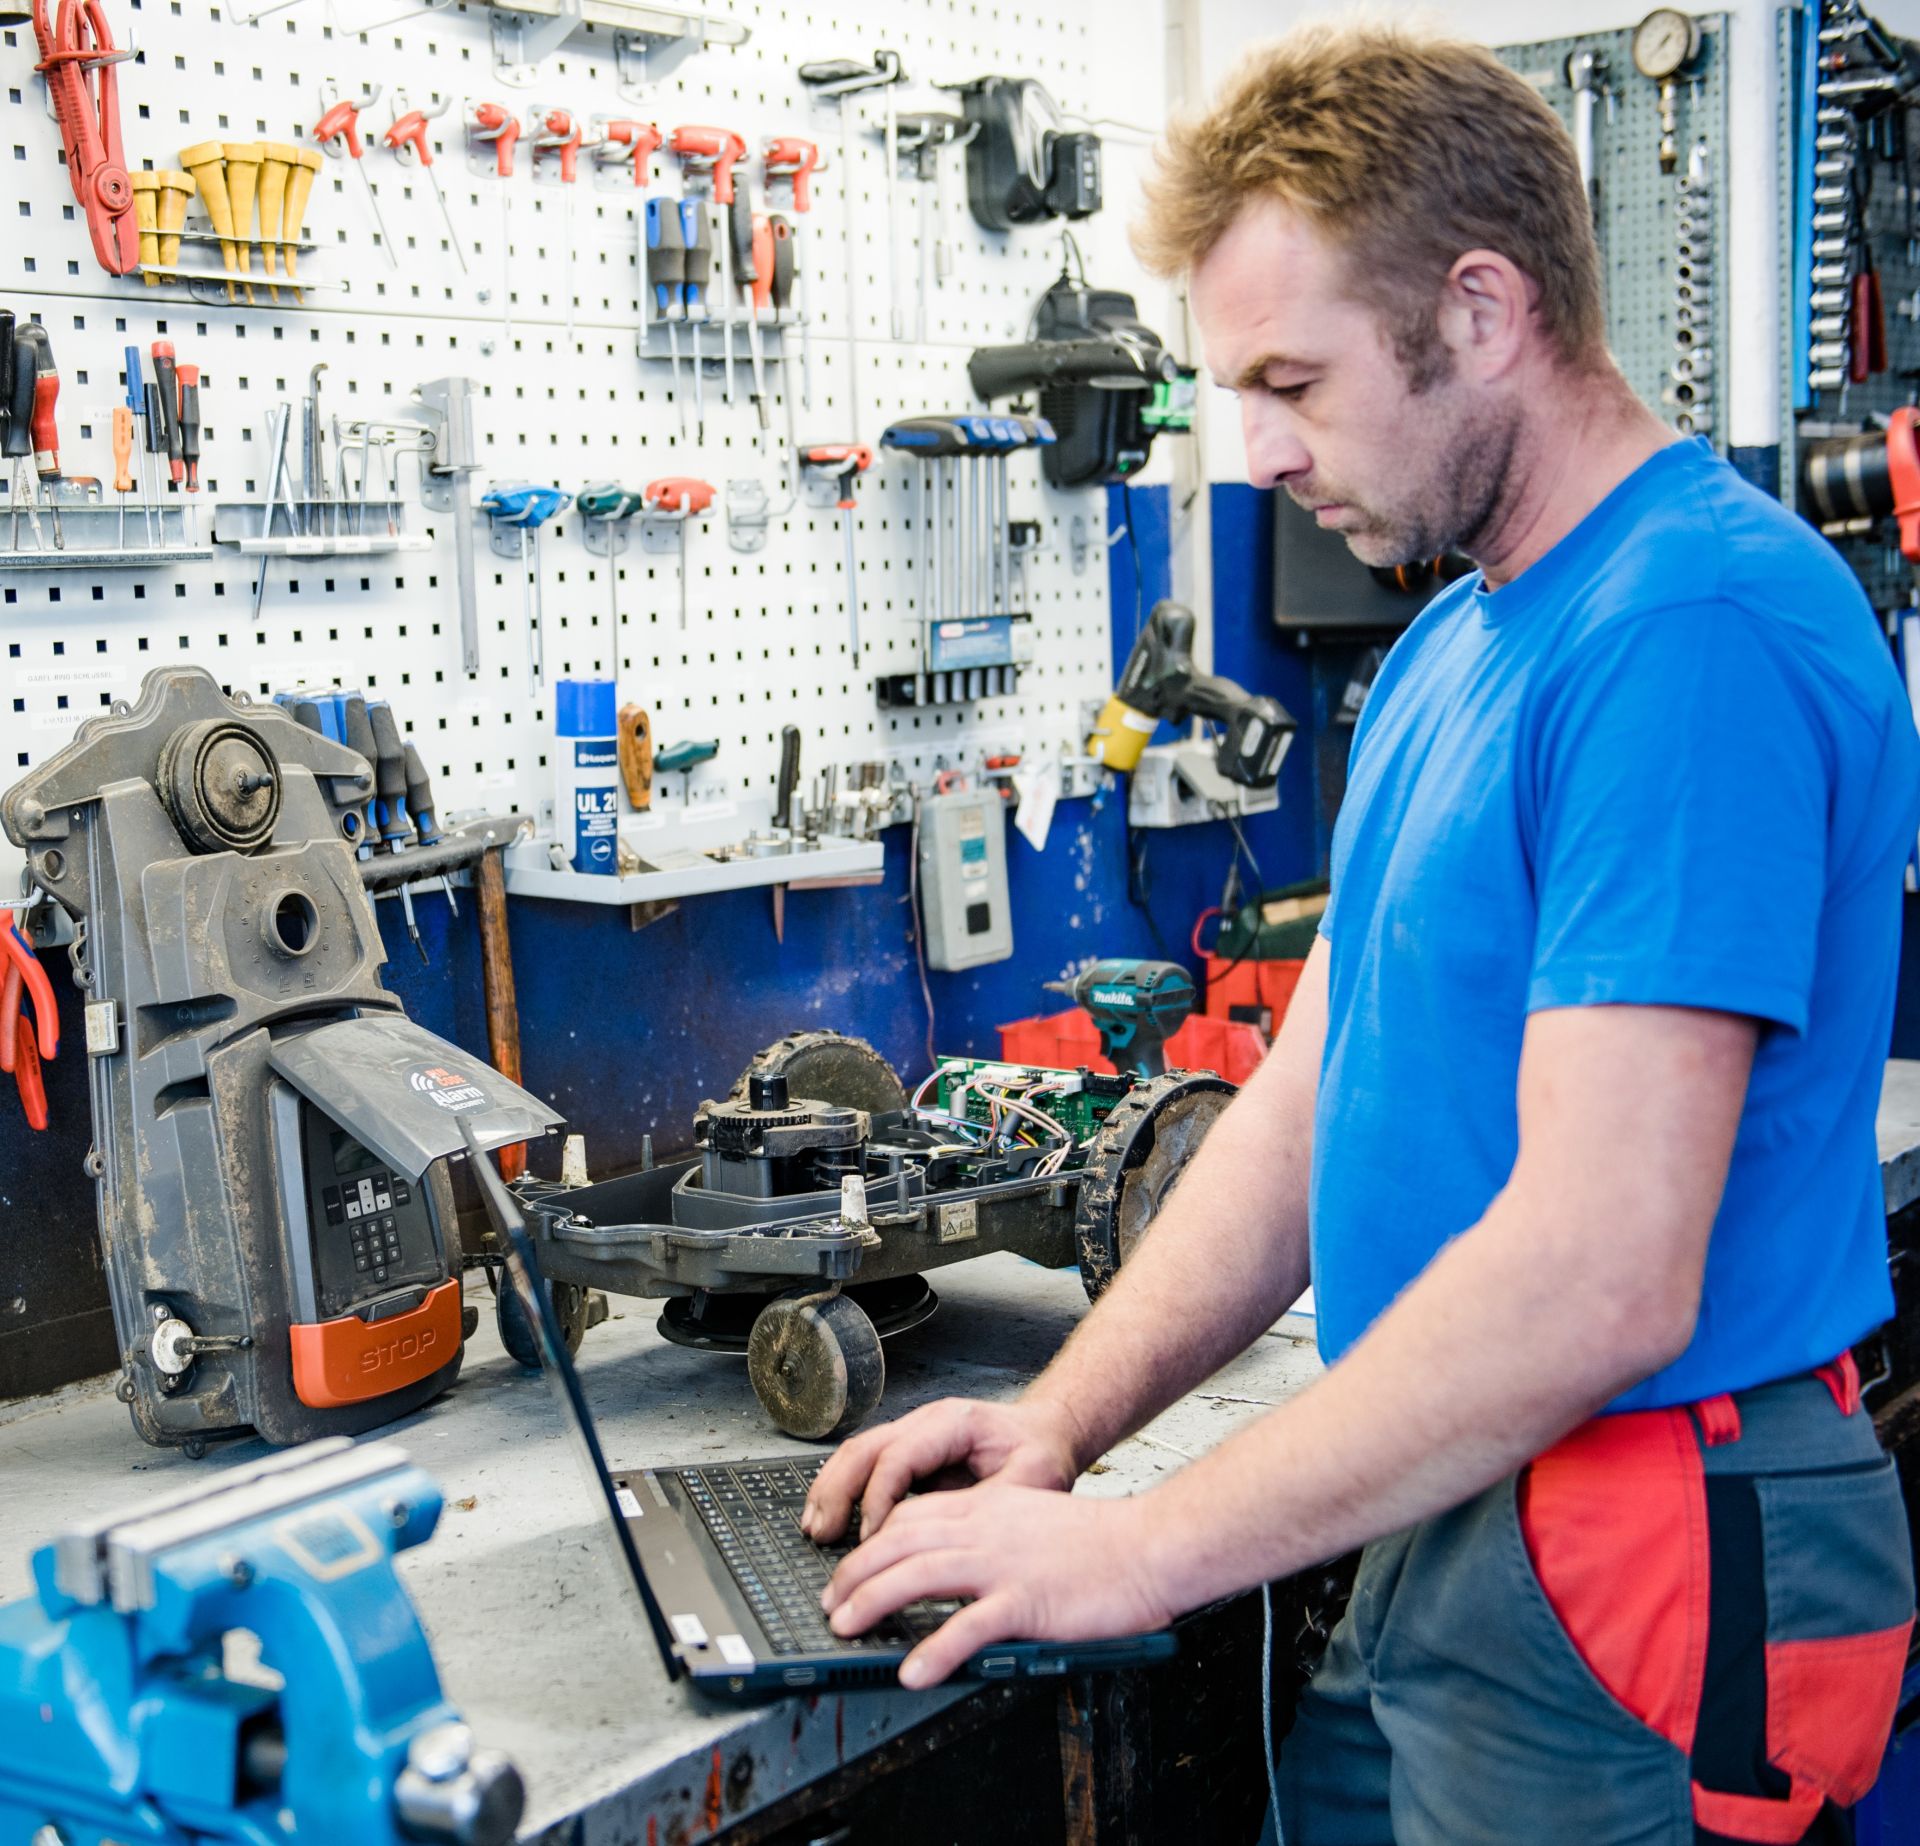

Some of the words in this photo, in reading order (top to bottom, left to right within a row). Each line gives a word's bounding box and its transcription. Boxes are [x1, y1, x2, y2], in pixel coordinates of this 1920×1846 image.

[577, 793, 600, 812] UL
[603, 791, 617, 812] 21
[428, 1087, 485, 1107] Alarm
[361, 1327, 437, 1373] STOP
